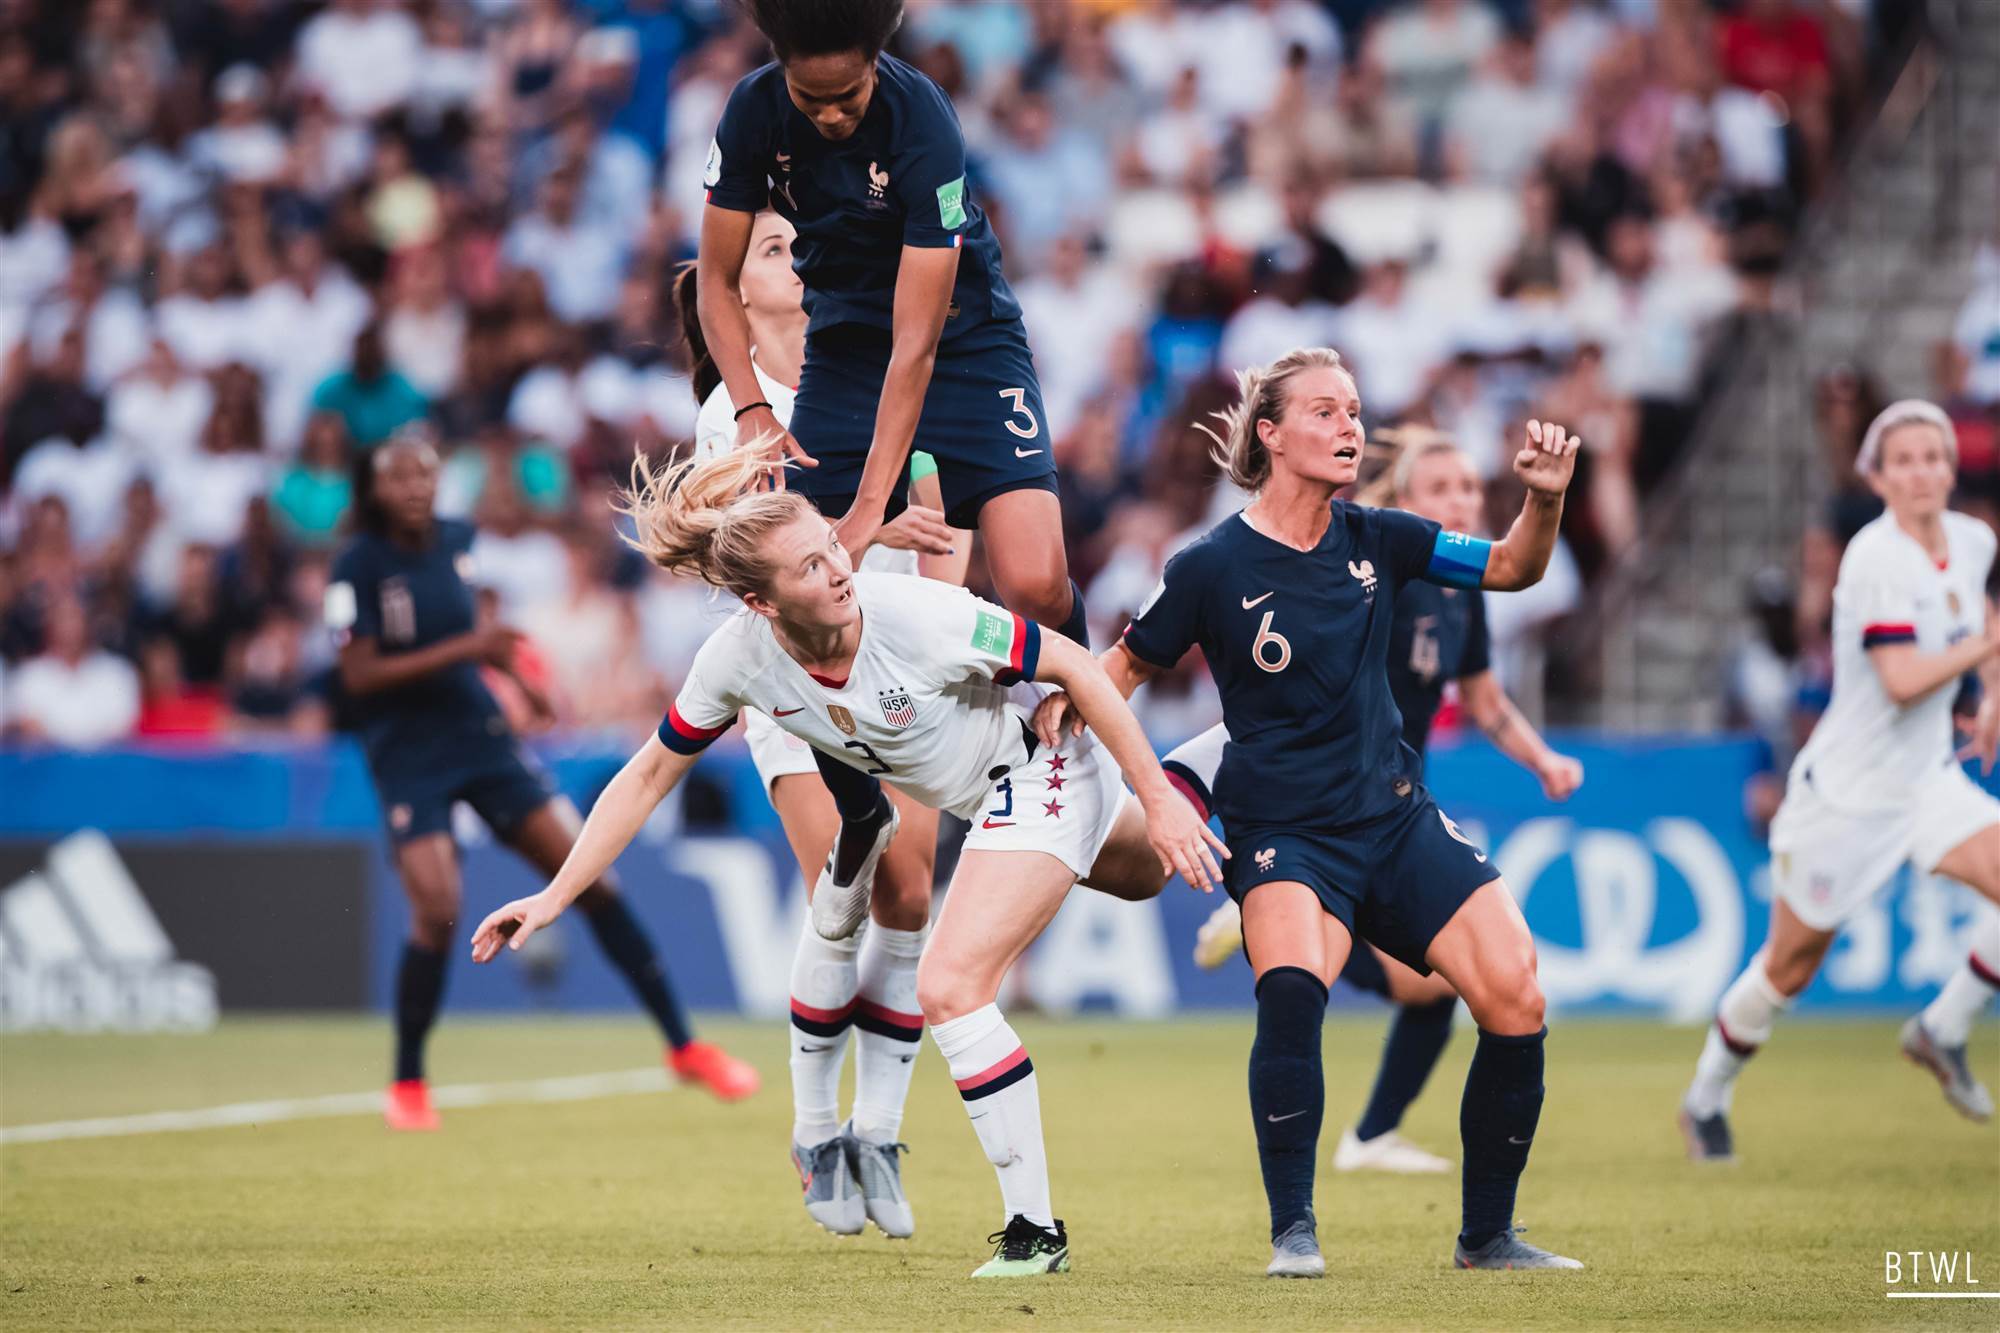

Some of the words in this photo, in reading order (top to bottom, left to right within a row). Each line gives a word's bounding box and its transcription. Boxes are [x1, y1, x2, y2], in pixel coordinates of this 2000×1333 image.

[998, 387, 1039, 439] 3
[1252, 610, 1292, 673] 6
[882, 696, 909, 712] USA
[844, 740, 894, 775] 3
